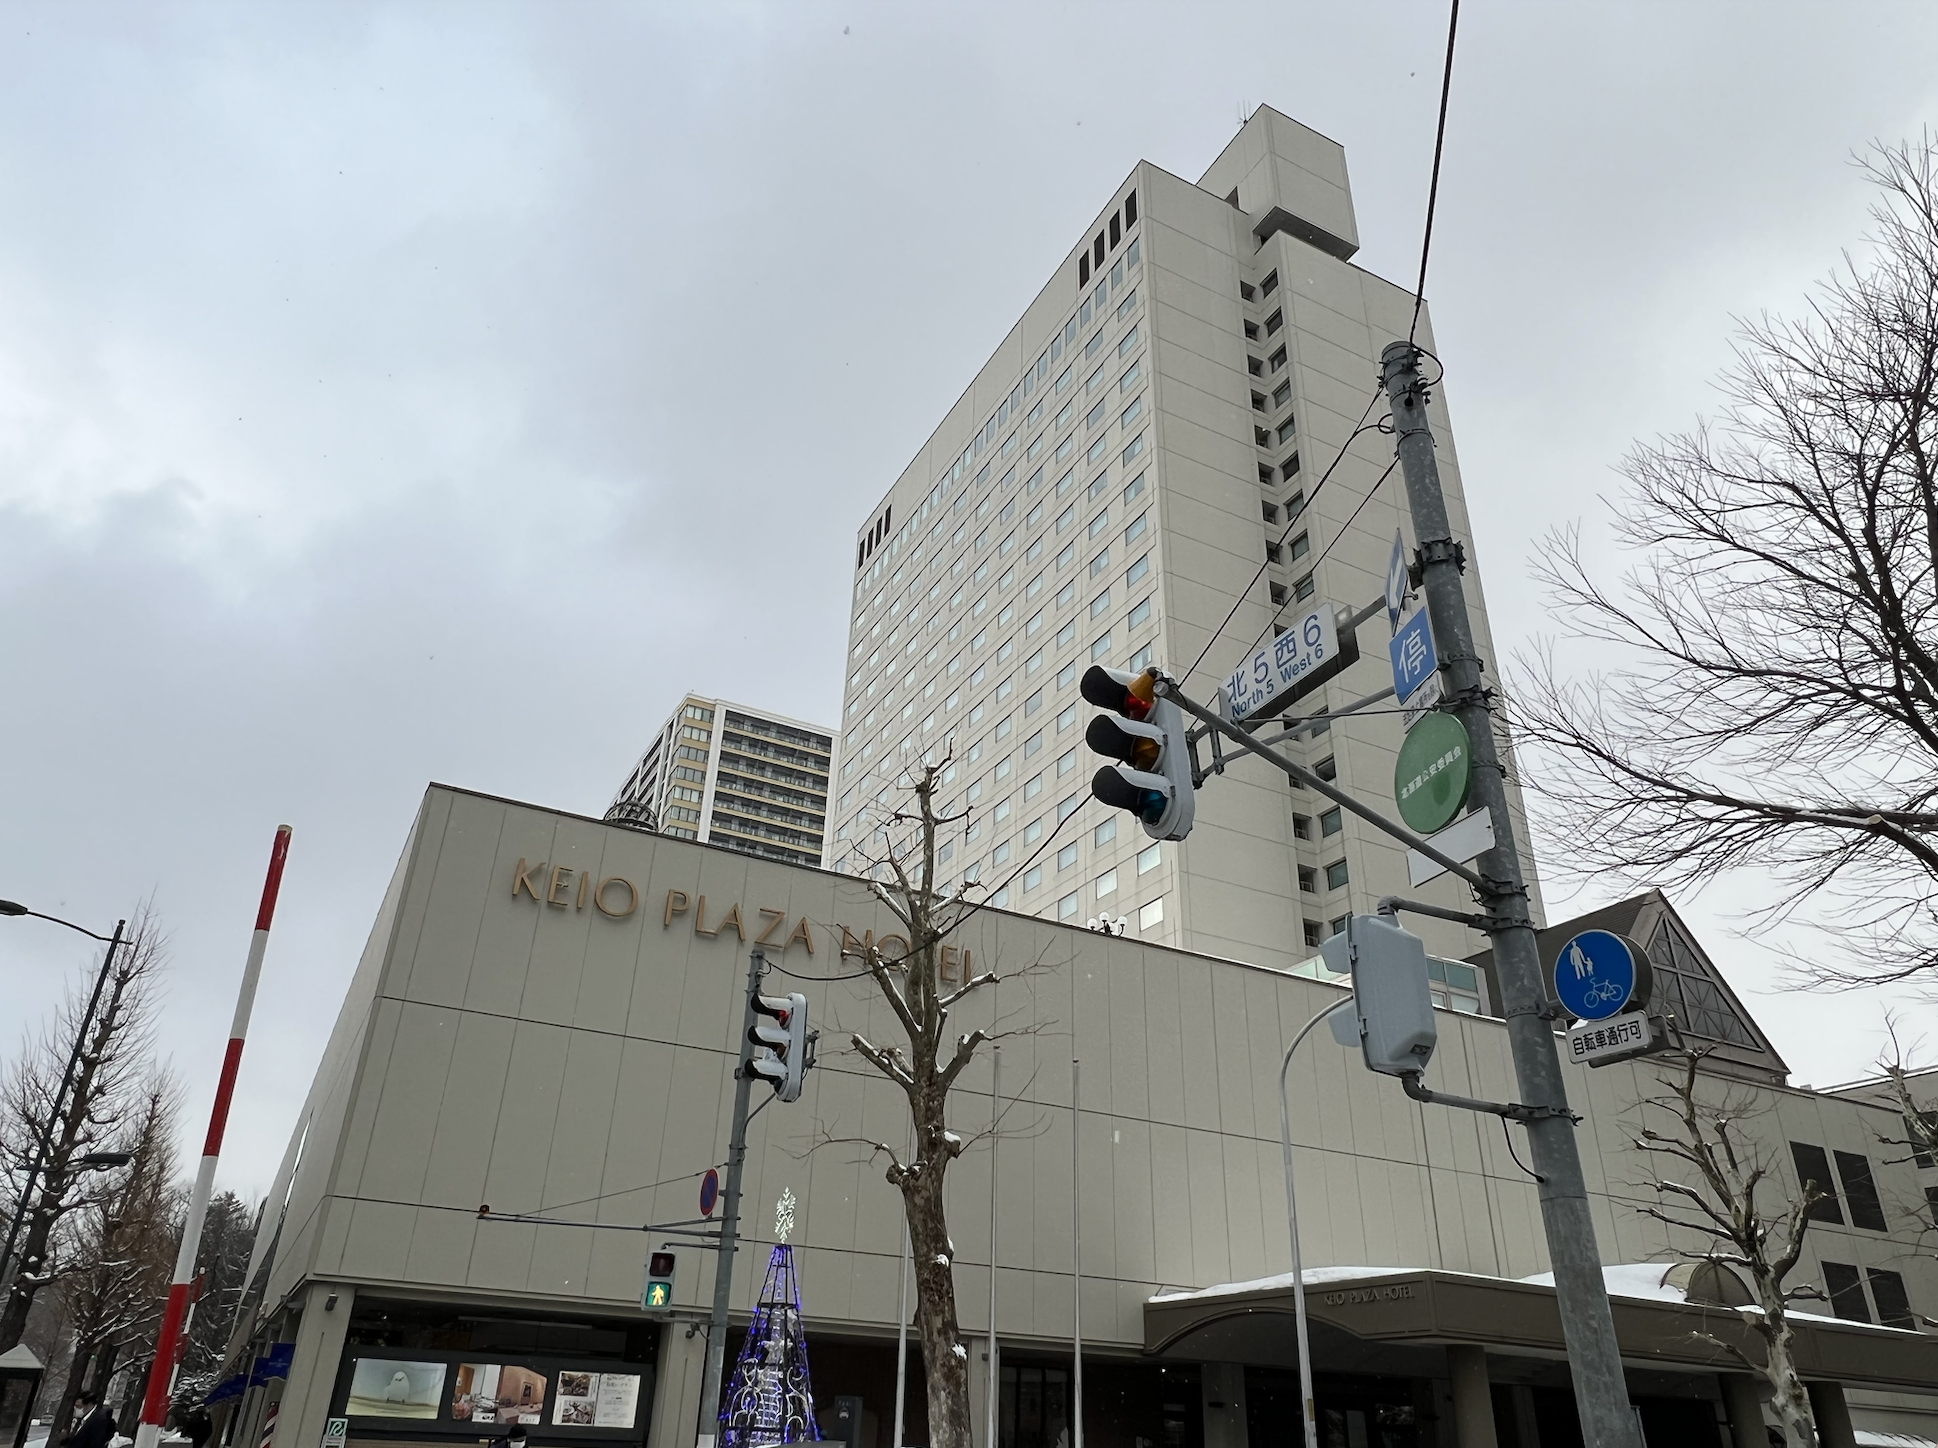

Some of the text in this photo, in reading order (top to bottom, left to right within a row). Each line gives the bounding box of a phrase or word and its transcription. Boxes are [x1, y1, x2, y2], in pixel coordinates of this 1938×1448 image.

[1231, 643, 1324, 718] North 5 West 6
[1399, 628, 1427, 683] 停
[512, 858, 973, 984] KEIO PLAZA HOEL
[1572, 1020, 1642, 1056] 自転車通行可
[1350, 1288, 1380, 1303] PLAZA
[1383, 1285, 1413, 1301] HOTEL
